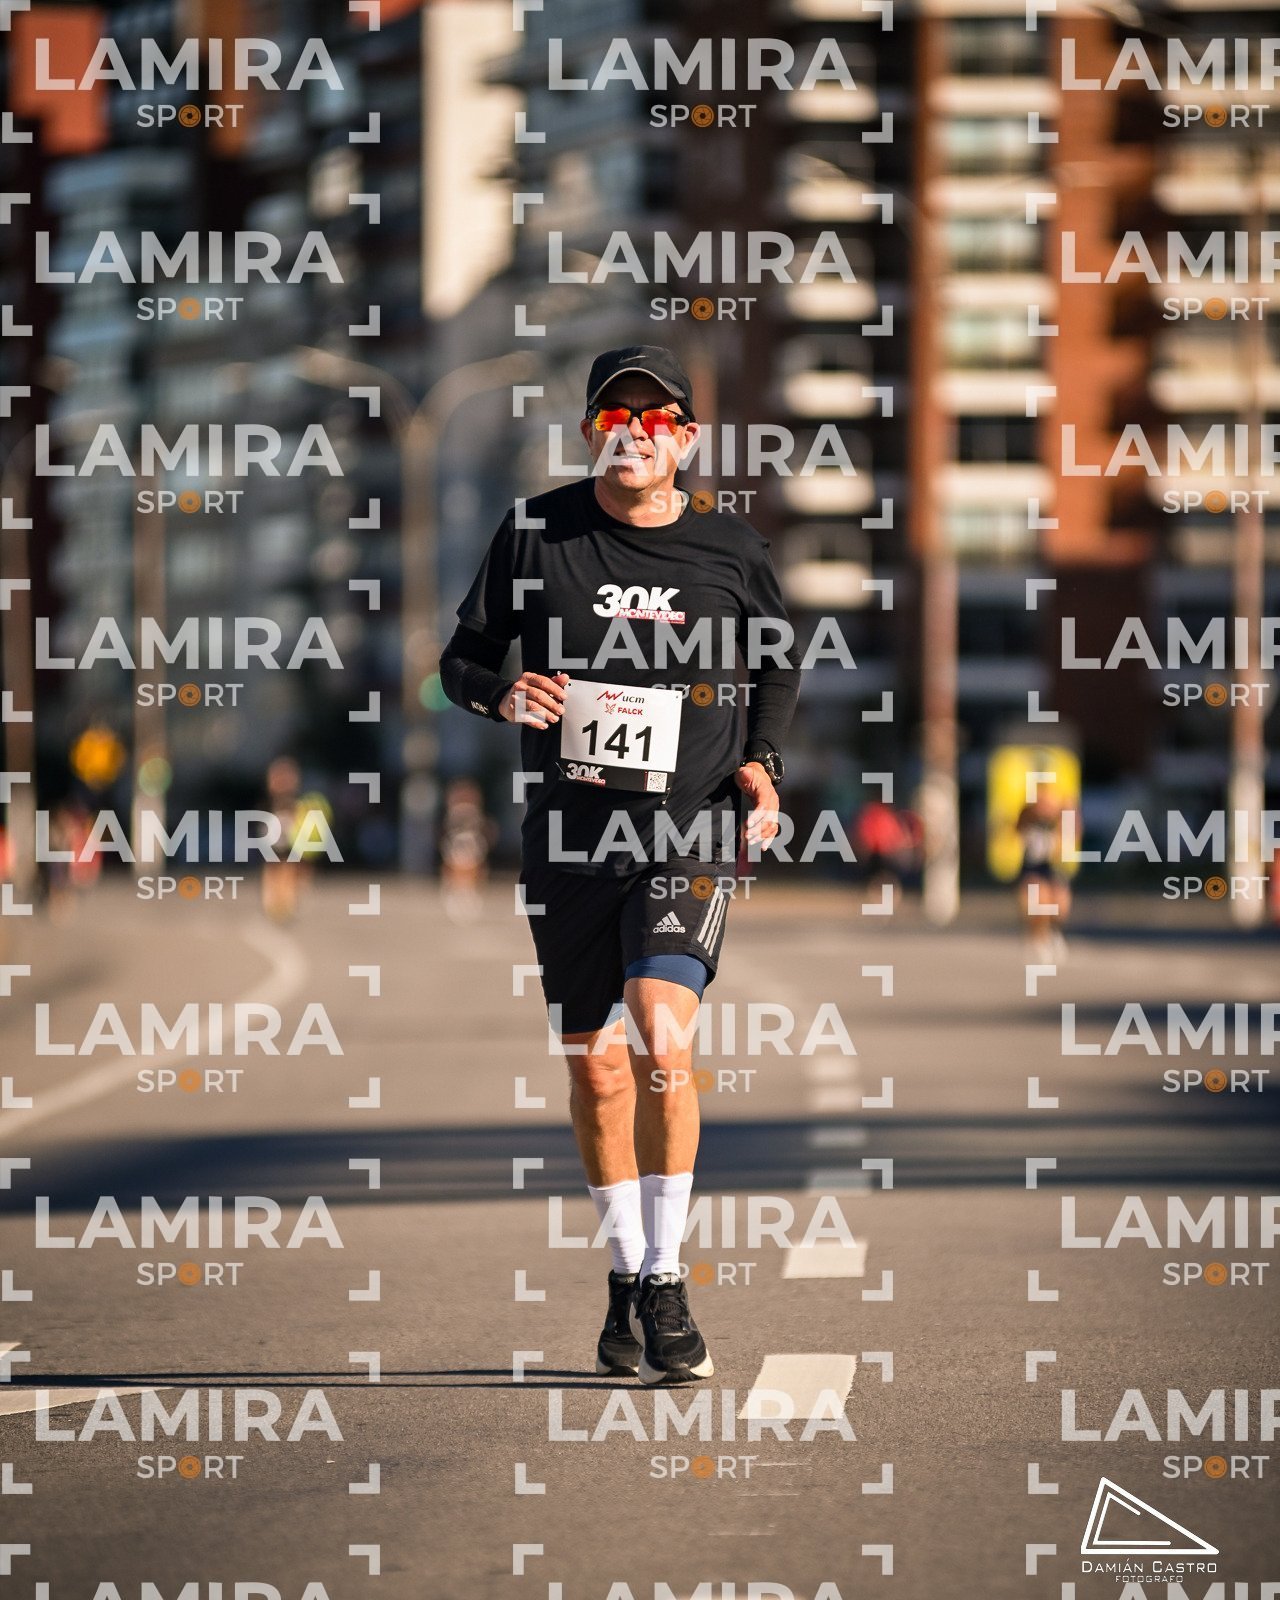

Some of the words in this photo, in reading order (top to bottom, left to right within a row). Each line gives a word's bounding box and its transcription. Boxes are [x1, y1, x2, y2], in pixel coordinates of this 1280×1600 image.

[593, 584, 680, 618] 30K
[619, 608, 685, 621] MONTEVIDEO
[622, 696, 645, 704] ucm
[617, 707, 643, 716] FALCK
[582, 720, 652, 762] 141
[566, 763, 604, 780] 30K
[652, 925, 686, 934] adidas
